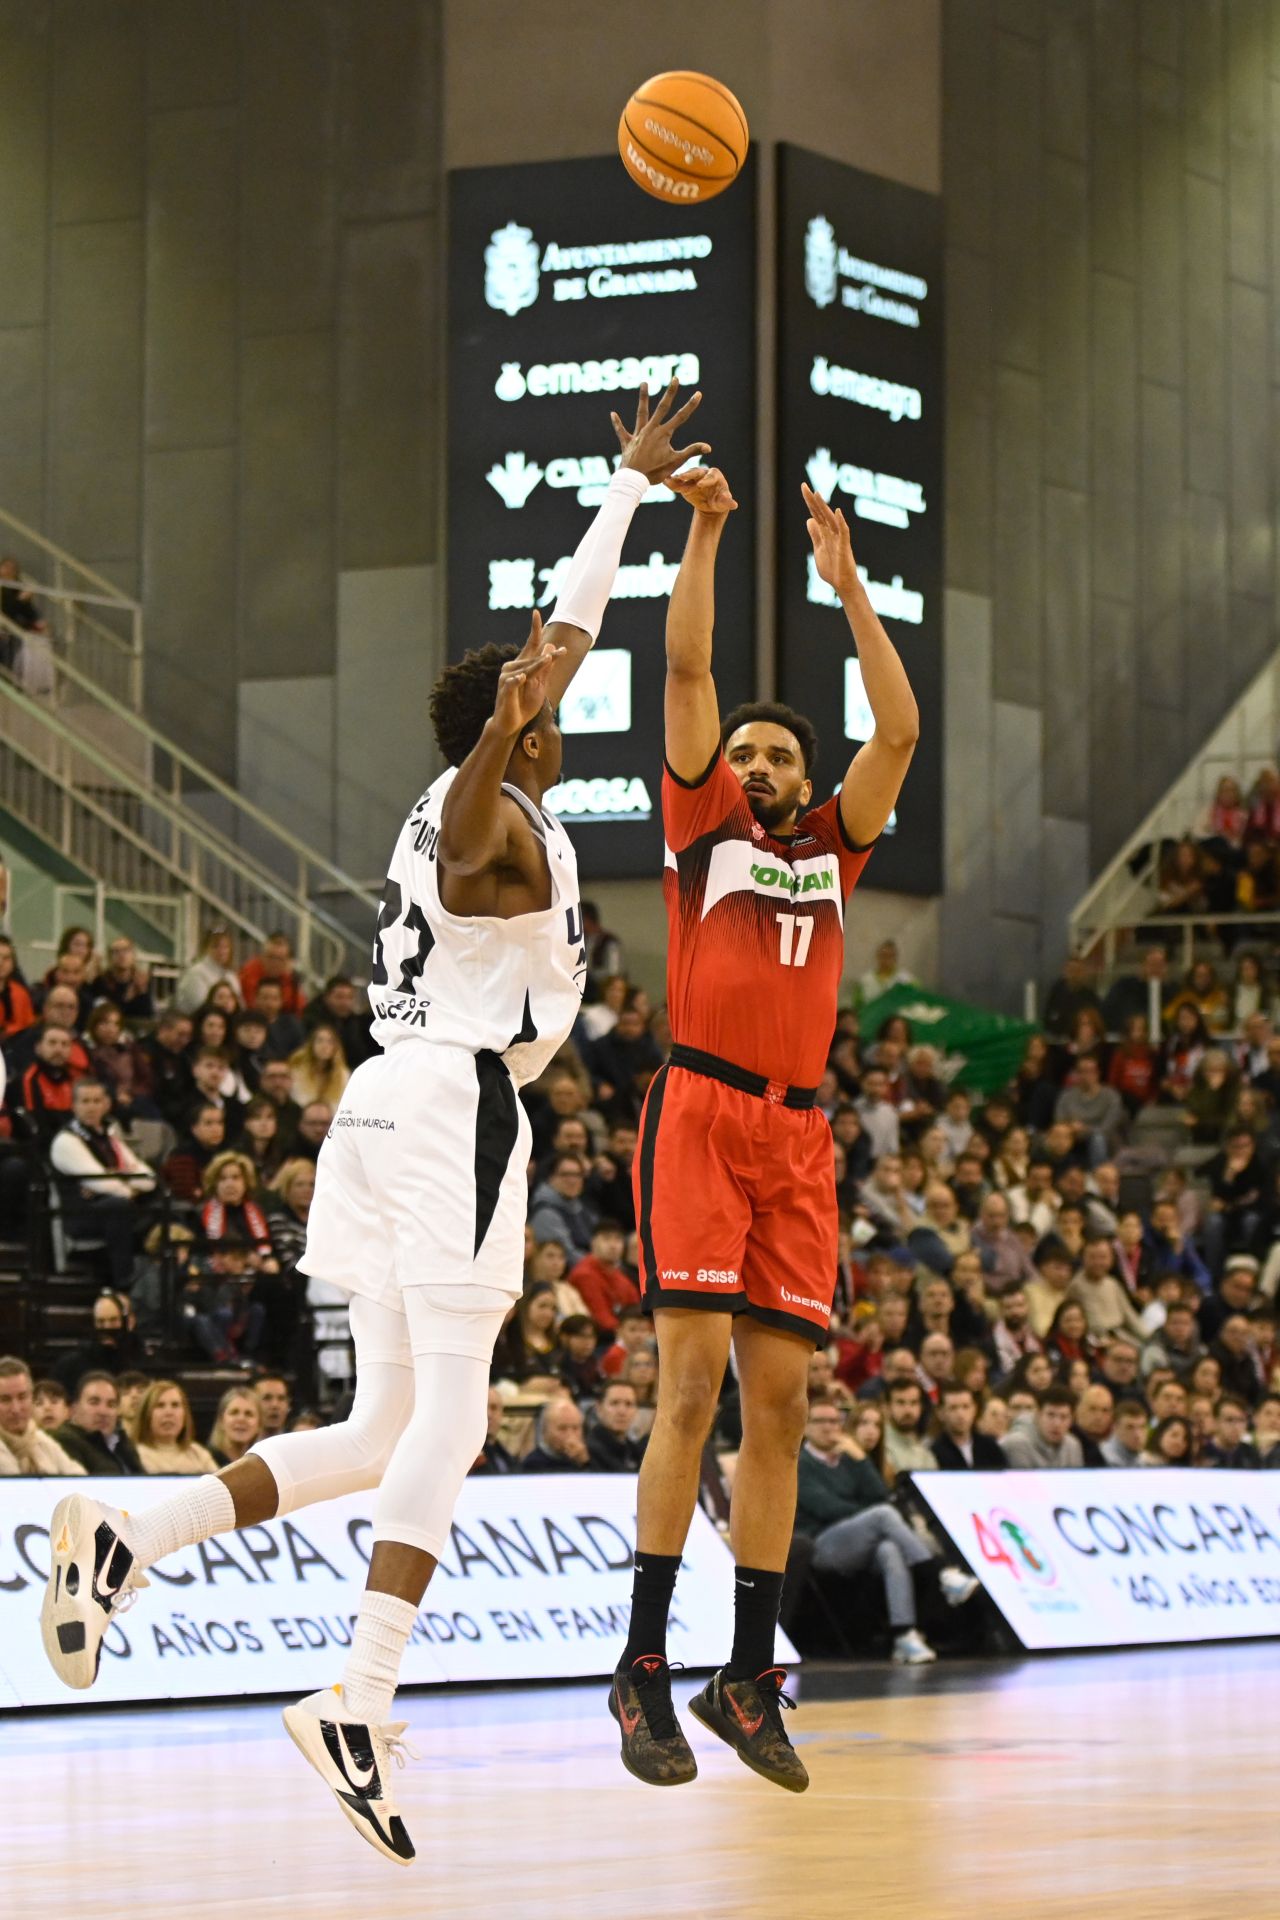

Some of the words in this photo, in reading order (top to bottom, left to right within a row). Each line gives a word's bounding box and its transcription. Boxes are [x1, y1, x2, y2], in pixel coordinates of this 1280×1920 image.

[527, 353, 700, 396] emasagra
[662, 1269, 689, 1281] vive
[1053, 1503, 1280, 1556] CONCAPA
[151, 1612, 264, 1658] AÑOS
[488, 1607, 543, 1641] EN
